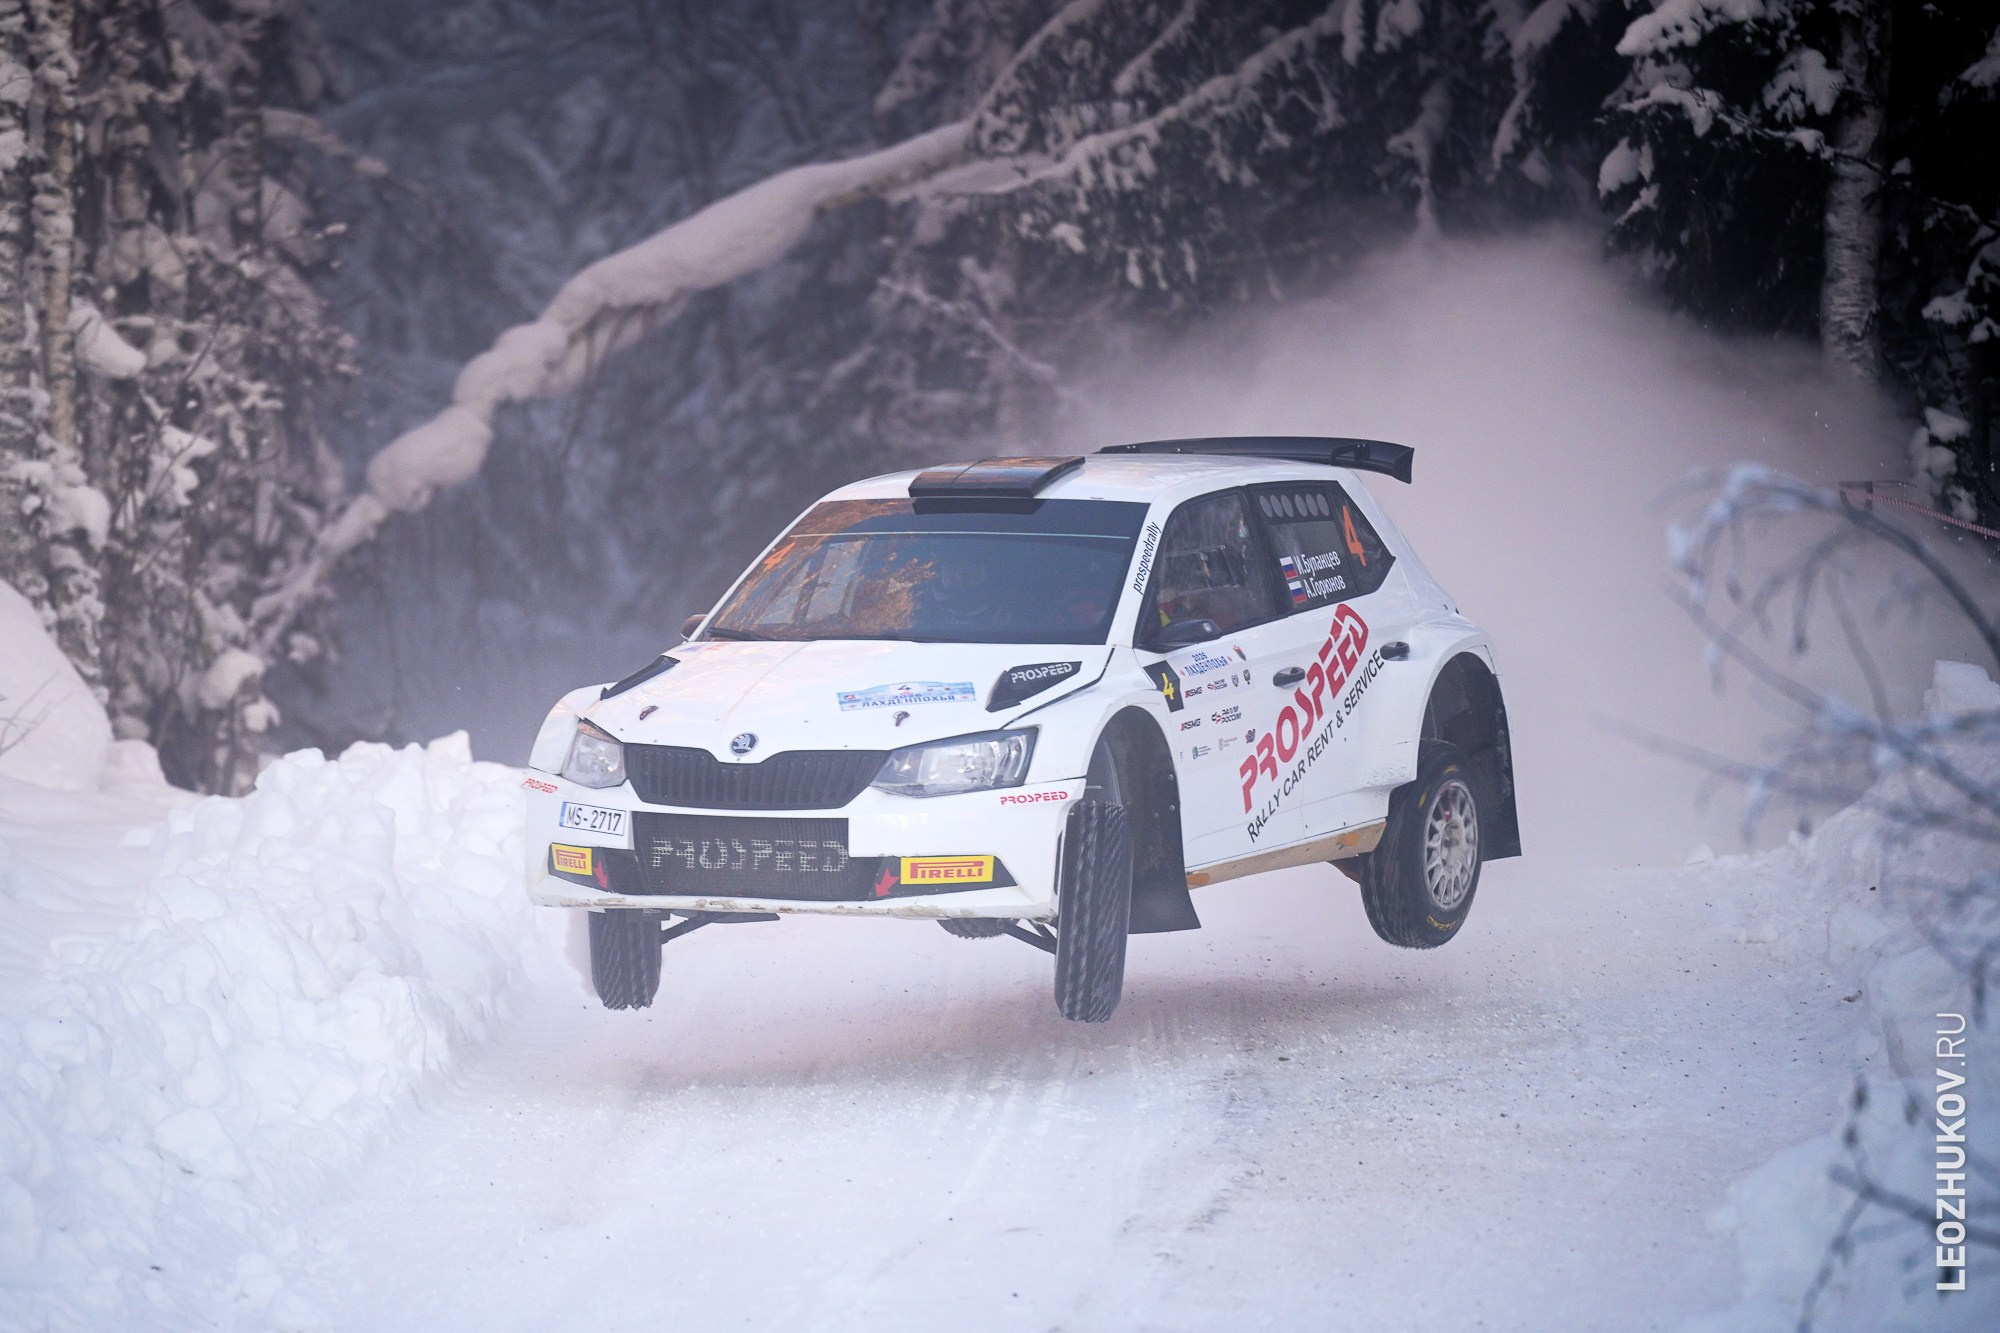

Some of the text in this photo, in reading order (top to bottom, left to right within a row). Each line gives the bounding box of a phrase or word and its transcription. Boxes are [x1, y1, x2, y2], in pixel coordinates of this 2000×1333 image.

[1342, 505, 1366, 567] 4
[763, 542, 796, 572] 4
[1133, 521, 1162, 595] prospeedrally
[1294, 551, 1341, 577] И.Буланцев
[1303, 575, 1346, 600] А.Горюнов
[1010, 663, 1072, 683] PROSPEED
[1162, 672, 1175, 700] 4
[1239, 603, 1369, 815] PROSPEED
[1247, 649, 1385, 843] RALLY CAR RENT & SERVICE
[1000, 791, 1068, 805] PROSPEED
[567, 806, 622, 832] MS-2717
[556, 848, 586, 870] PIRELLI
[910, 861, 984, 879] PIRELLI
